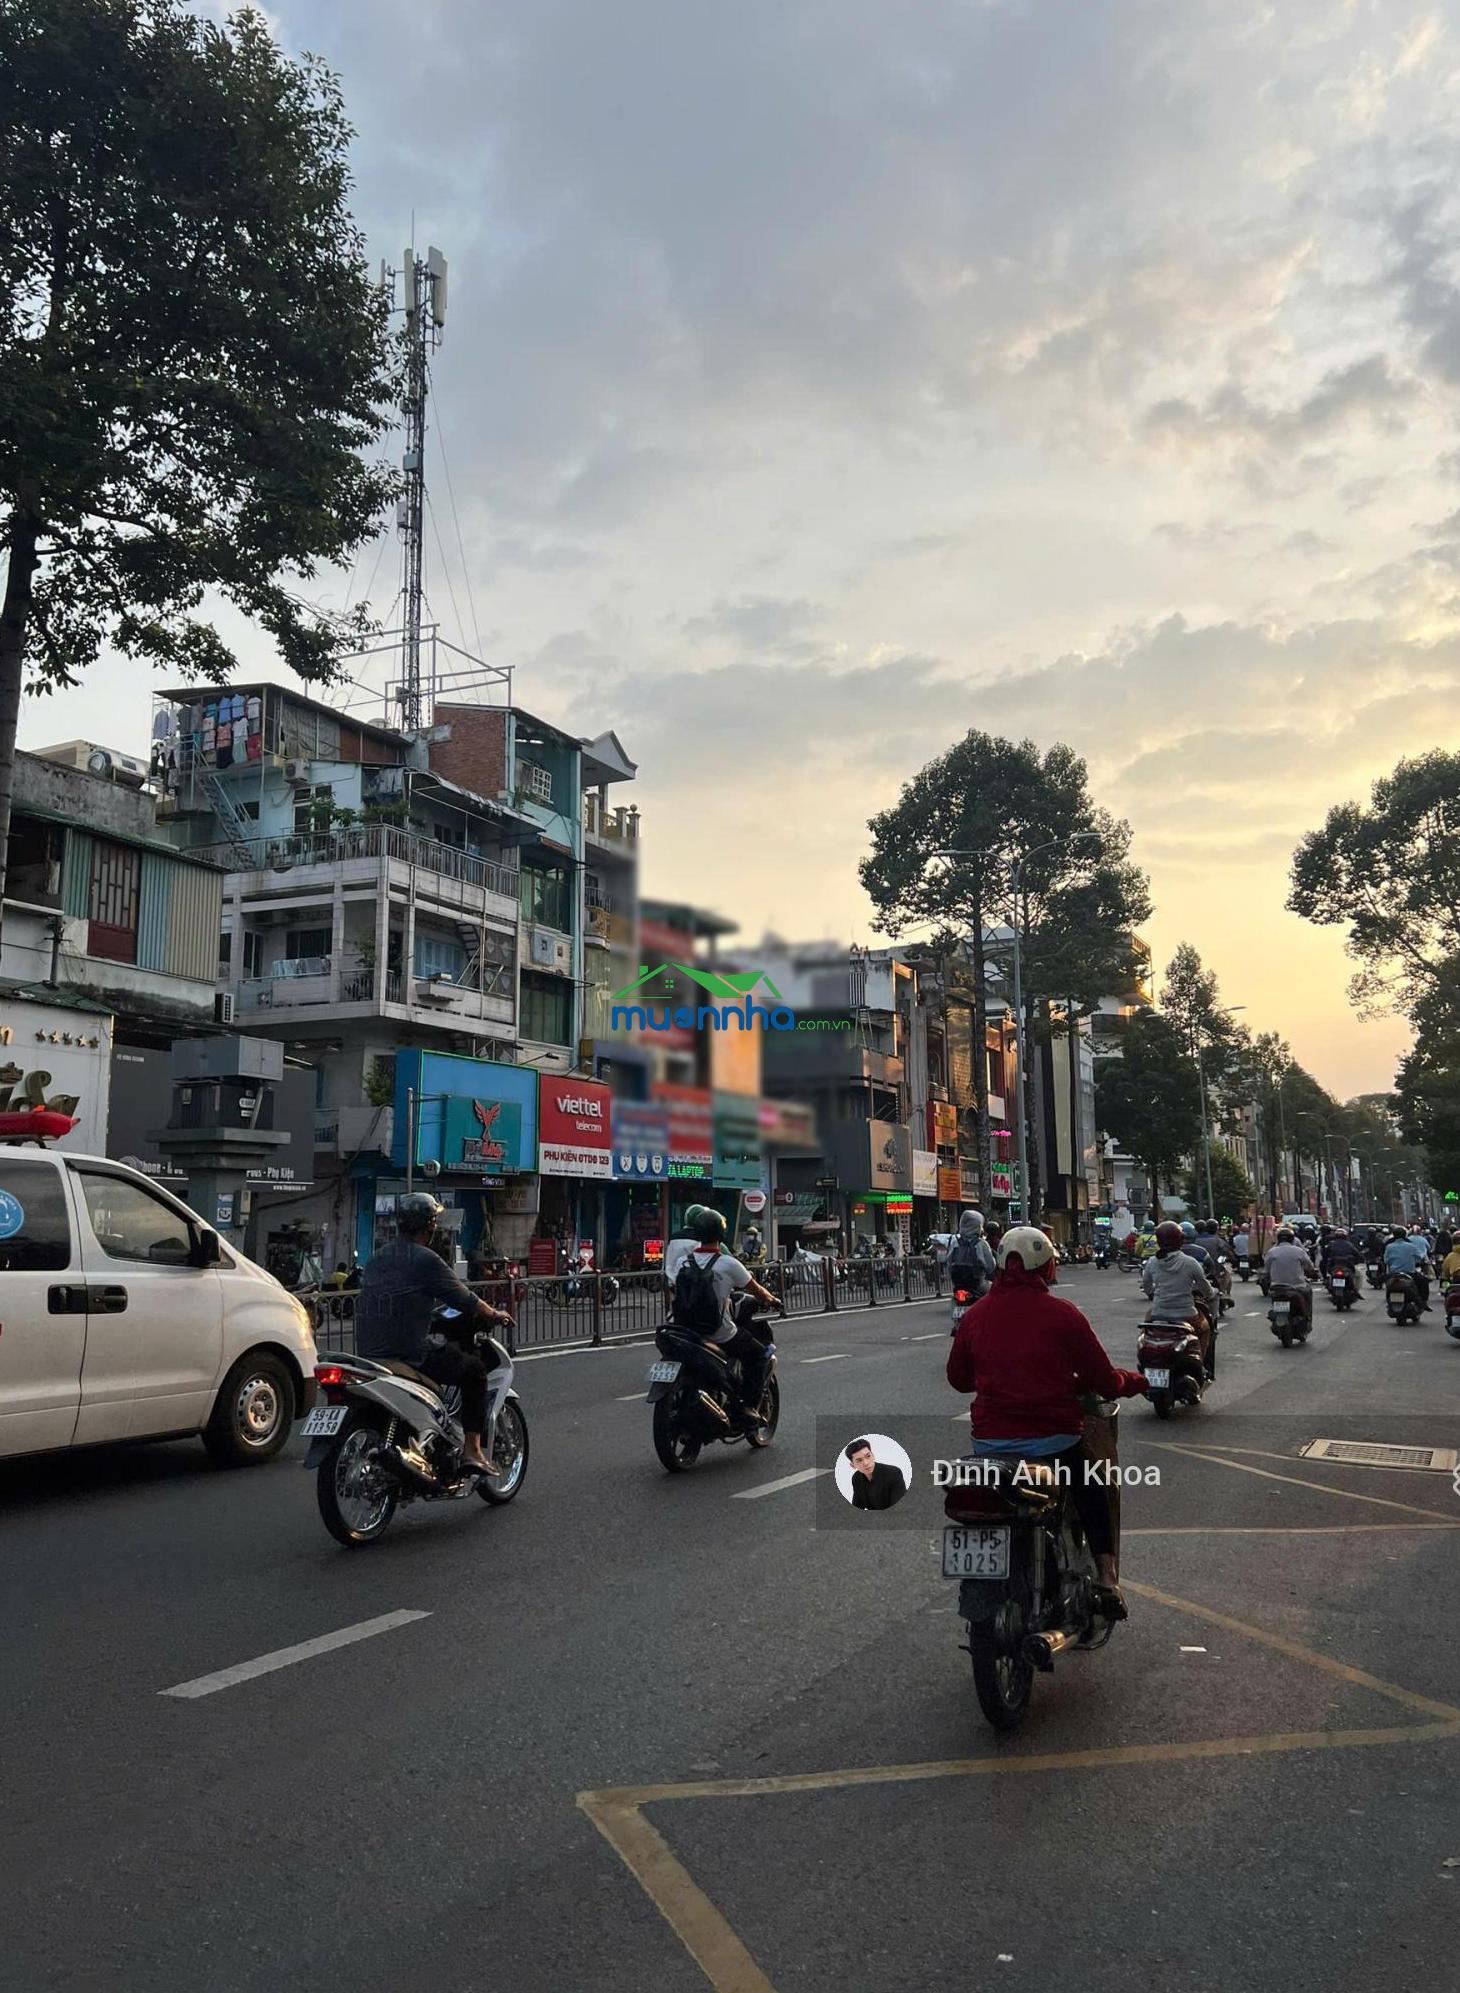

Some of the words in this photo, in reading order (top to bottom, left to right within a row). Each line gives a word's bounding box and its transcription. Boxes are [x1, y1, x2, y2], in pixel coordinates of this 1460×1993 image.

[556, 1094, 603, 1118] viettel
[575, 1120, 602, 1133] telecom
[543, 1150, 561, 1164] PHỤ
